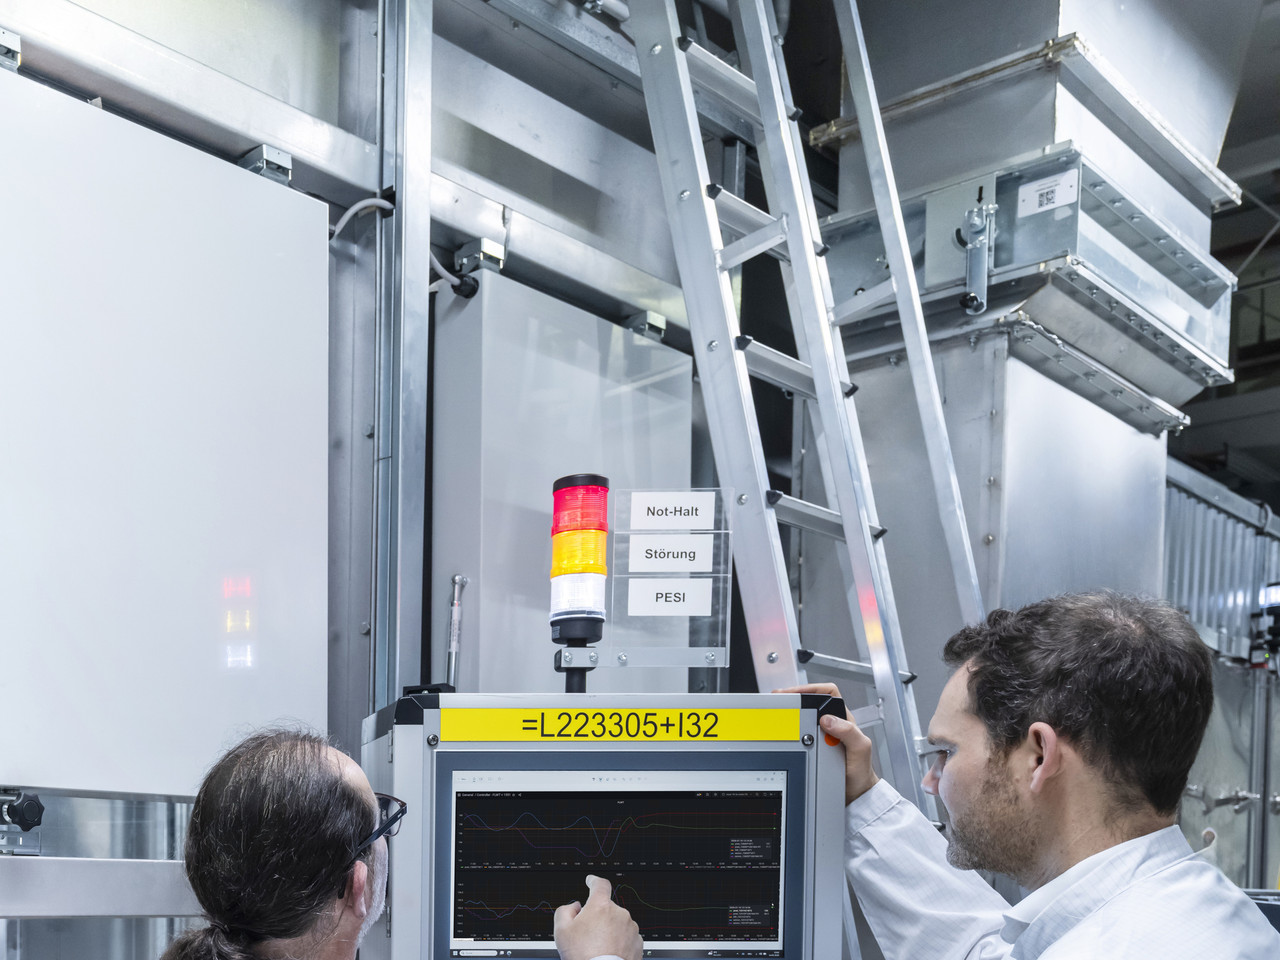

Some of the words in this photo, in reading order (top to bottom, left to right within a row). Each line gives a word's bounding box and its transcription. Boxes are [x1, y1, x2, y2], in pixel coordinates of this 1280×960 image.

[646, 506, 699, 517] Not-Halt
[645, 547, 696, 561] Störung
[655, 592, 686, 603] PESI
